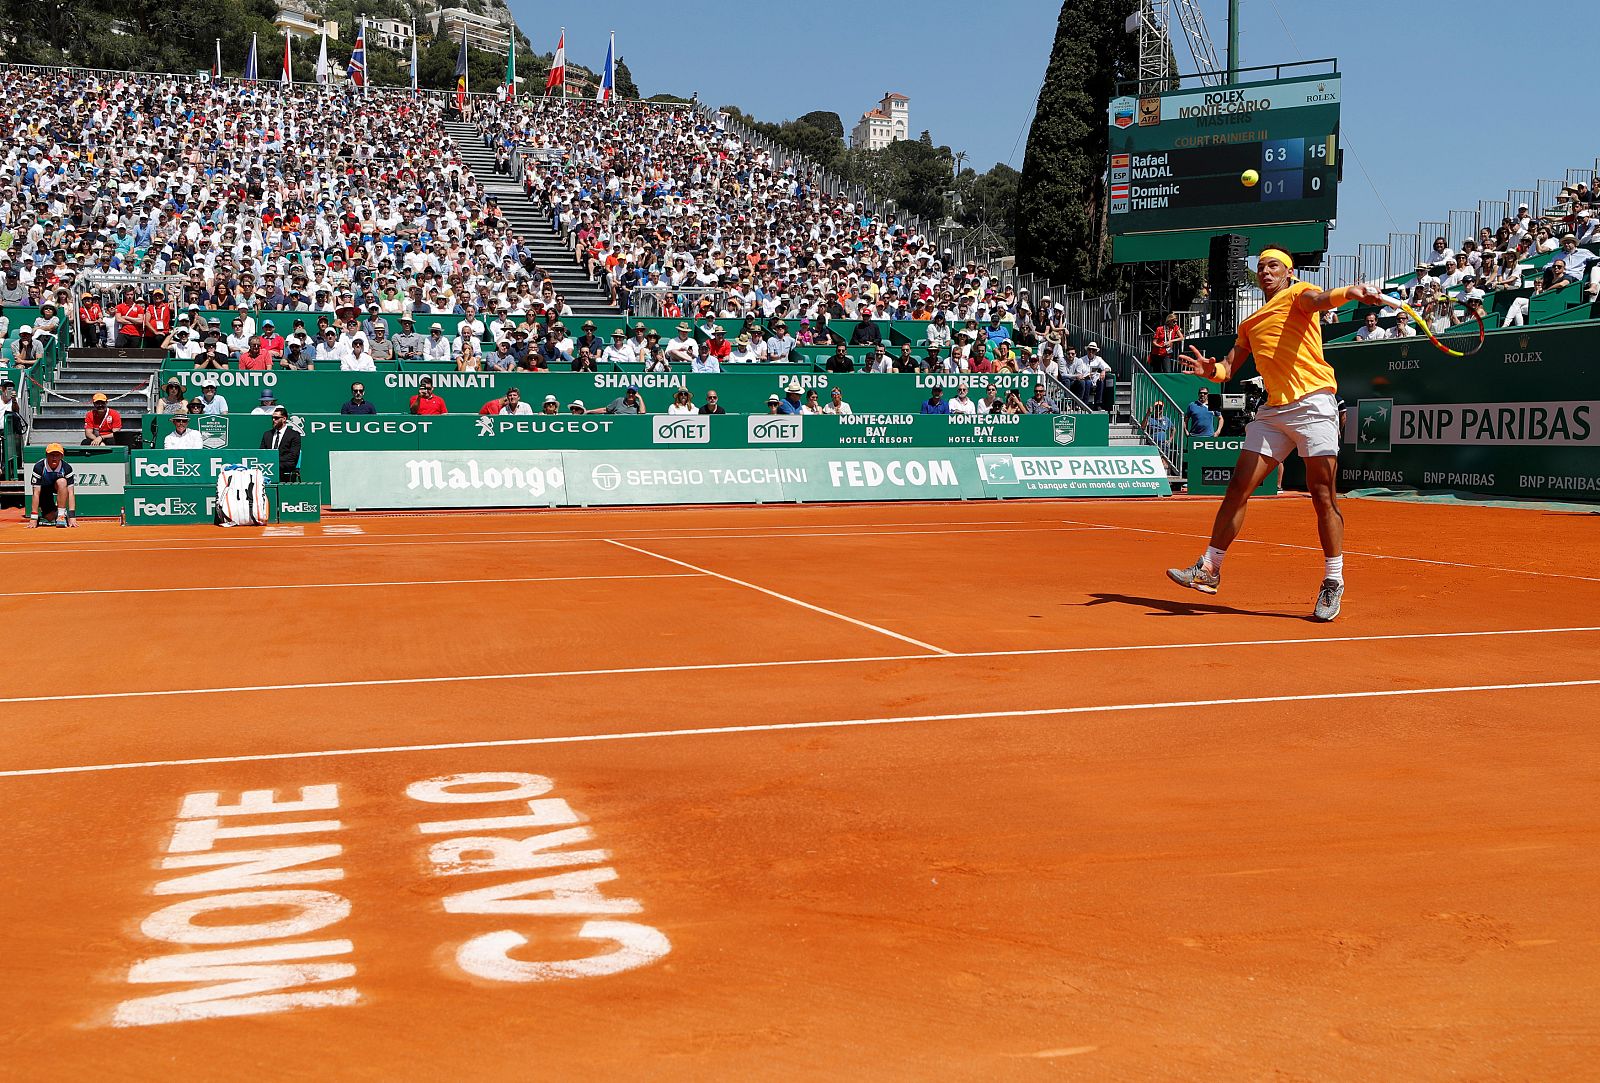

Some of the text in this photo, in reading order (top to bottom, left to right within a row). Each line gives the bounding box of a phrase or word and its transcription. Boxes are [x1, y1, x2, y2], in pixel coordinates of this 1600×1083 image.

[200, 73, 210, 84] D
[1204, 90, 1245, 105] ROLEX
[1306, 93, 1336, 102] ROLEX
[1179, 98, 1271, 119] MONTE-CARLO
[1141, 115, 1158, 123] ATP
[1197, 112, 1252, 128] MASTERS
[1175, 130, 1268, 148] COURT RAINIER III
[1132, 153, 1168, 167] Rafael
[1265, 144, 1326, 162] 6 3 15
[1113, 172, 1127, 180] ESP
[1132, 167, 1173, 180] NADAL
[1131, 184, 1180, 198] Dominic
[1264, 177, 1321, 194] 0 1 0
[1112, 202, 1127, 211] AUT
[1131, 197, 1169, 210] THIEM
[1102, 292, 1114, 302] LOGE
[1103, 303, 1112, 320] K
[1504, 351, 1542, 363] ROLEX
[1389, 360, 1420, 371] ROLEX
[177, 371, 278, 387] TORONTO
[594, 374, 687, 388] SHANGHAI
[778, 375, 828, 388] PARIS
[916, 375, 1029, 388] LONDRES 2018
[311, 421, 433, 434] PEUGEOT
[500, 420, 614, 433] PEUGEOT
[1400, 405, 1591, 440] BNP PARIBAS
[866, 427, 887, 436] BAY
[974, 426, 994, 436] BAY
[1193, 441, 1245, 450] PEUG
[135, 457, 200, 477] FedEx
[828, 460, 959, 487] FEDCOM
[1021, 459, 1155, 476] BNP PARIBAS
[405, 459, 564, 497] Malongo
[627, 468, 808, 485] SERGIO TACCHINI
[1204, 470, 1231, 481] 209
[1343, 469, 1403, 483] BNP PARIBAS
[1424, 472, 1495, 486] BNP PARIBAS
[1027, 480, 1160, 491] La banque d'un monde qui change
[1519, 475, 1600, 491] BNP PARIBAS
[133, 498, 197, 517] FedEx
[281, 502, 318, 513] FedEx
[405, 771, 672, 983] CARLO
[112, 783, 360, 1028] MONTE
